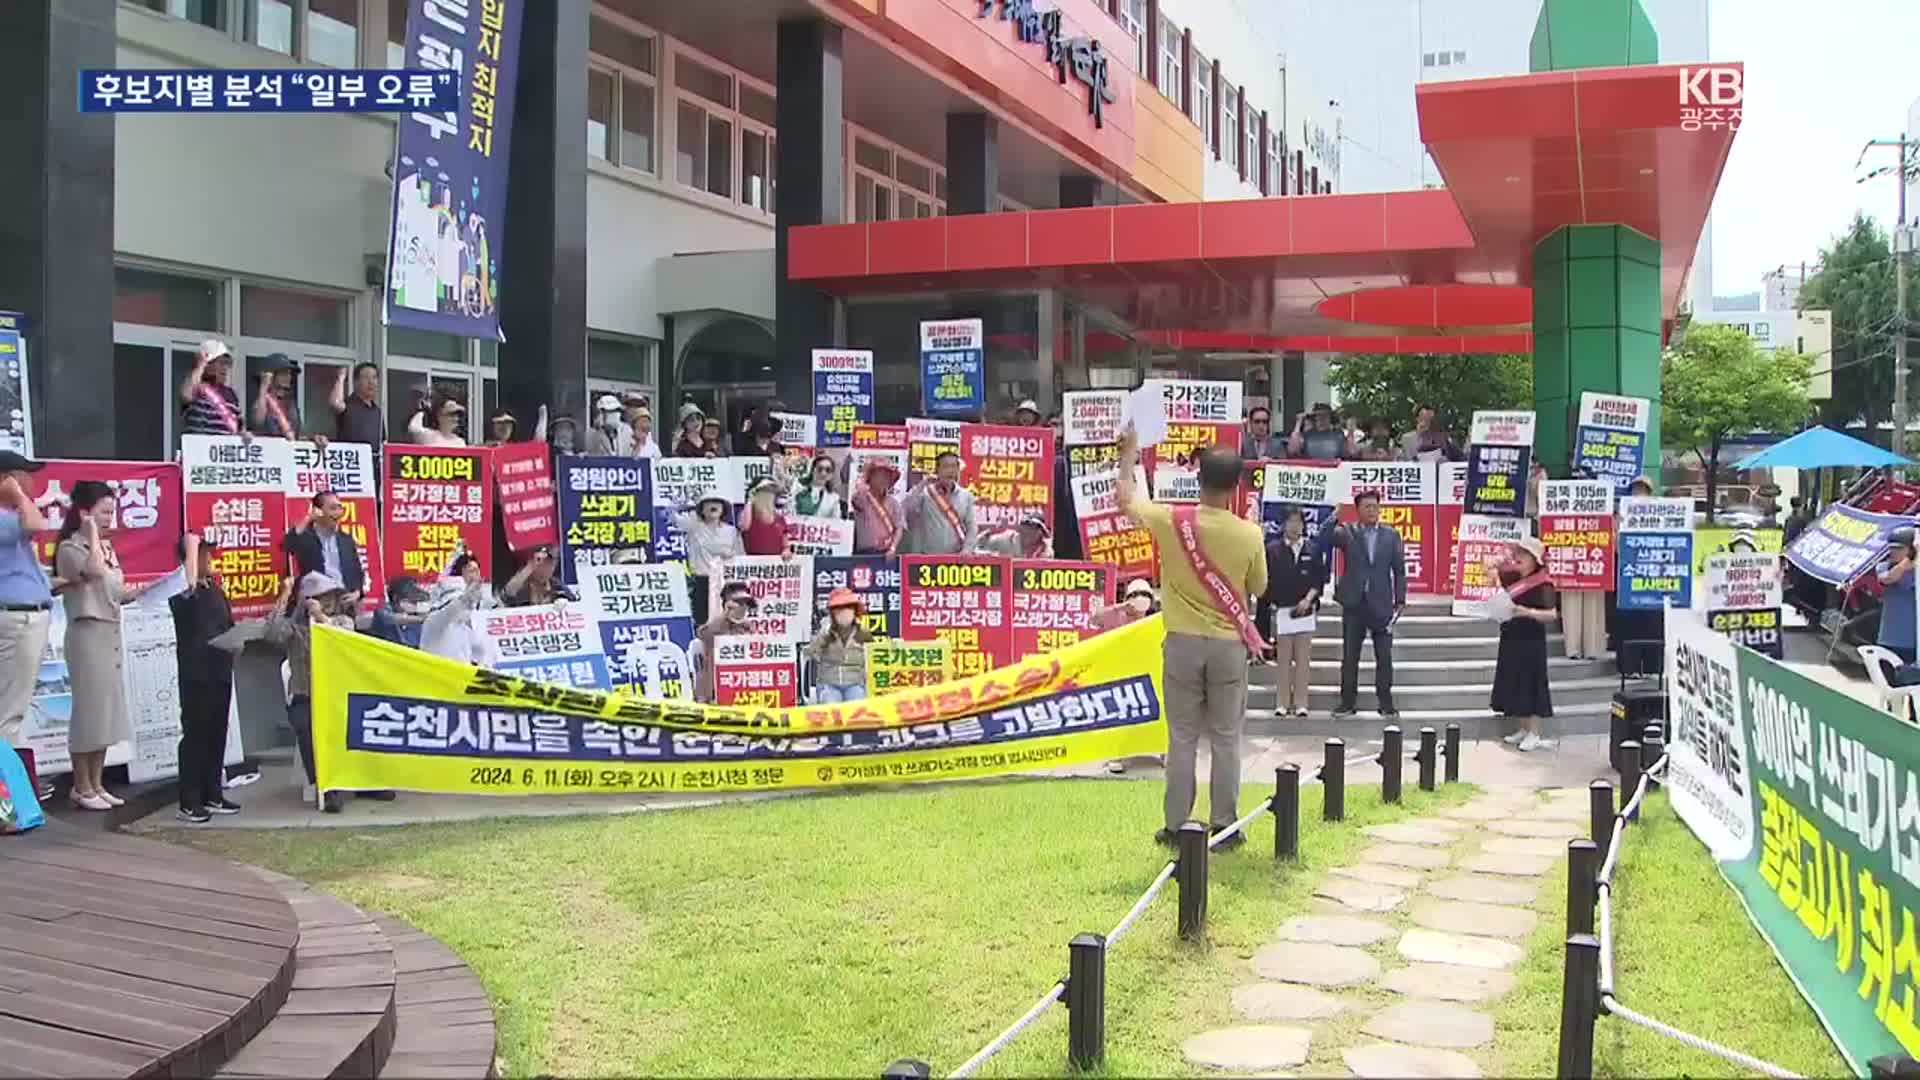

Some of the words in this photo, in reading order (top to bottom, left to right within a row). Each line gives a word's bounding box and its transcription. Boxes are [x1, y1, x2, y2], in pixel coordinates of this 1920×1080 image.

[468, 61, 498, 157] 최적지
[1166, 424, 1217, 445] 쓰레기
[209, 444, 263, 463] 아름다운
[971, 435, 1044, 458] 정원안의
[294, 448, 361, 470] 국가정원
[401, 455, 473, 480] 3,000억
[979, 458, 1035, 480] 쓰레기
[190, 466, 282, 485] 생물권보전지역
[568, 467, 643, 492] 정원안의
[655, 465, 683, 483] 10년
[687, 464, 716, 482] 가꾼
[1351, 467, 1422, 484] 국가정원
[391, 483, 461, 503] 국가정원
[467, 485, 482, 504] 옆
[1016, 483, 1049, 505] 계획
[1278, 487, 1326, 501] 국가정원
[1575, 485, 1607, 498] 105m
[211, 498, 264, 523] 순천을
[391, 503, 483, 523] 쓰레기소각장
[580, 494, 636, 518] 쓰레기
[1378, 506, 1413, 525] 레기
[1546, 499, 1570, 512] 하루
[417, 524, 460, 550] 전면
[567, 521, 616, 545] 소각장
[618, 520, 651, 544] 계획
[1542, 530, 1610, 546] 쓰레기소각장
[1589, 547, 1604, 560] 수
[1637, 547, 1675, 562] 쓰레기
[919, 564, 992, 587] 3,000억
[1548, 560, 1575, 576] 없는
[1577, 561, 1605, 576] 재앙
[1622, 563, 1661, 577] 소각장
[597, 572, 632, 594] 10년
[635, 571, 671, 591] 가꾼
[816, 569, 848, 589] 순천
[1023, 568, 1097, 591] 3,000억
[602, 593, 674, 615] 국가정원
[910, 590, 979, 609] 국가정원
[985, 590, 1002, 609] 옆
[1013, 593, 1082, 612] 국가정원
[486, 611, 585, 637] 공론화없는
[910, 609, 1002, 627] 쓰레기소각장
[1012, 611, 1101, 630] 쓰레기소각
[498, 632, 582, 657] 밀실행정
[719, 644, 745, 660] 순천
[872, 647, 944, 667] 국가정원
[719, 670, 774, 687] 국가정원
[776, 670, 791, 686] 옆
[732, 689, 780, 707] 쓰레기
[361, 701, 570, 755] 순천시민을
[991, 682, 1152, 737] 고발한다!!
[1747, 676, 1817, 809] 3000억
[838, 764, 888, 779] 국가정원
[905, 757, 980, 776] 쓰레기소각장
[979, 754, 1007, 769] 반대
[470, 767, 515, 785] 2024.
[522, 768, 538, 786] 6.
[600, 768, 634, 787] 오후
[638, 770, 665, 788] 2시
[681, 769, 749, 788] 순천시청
[752, 768, 785, 785] 정문
